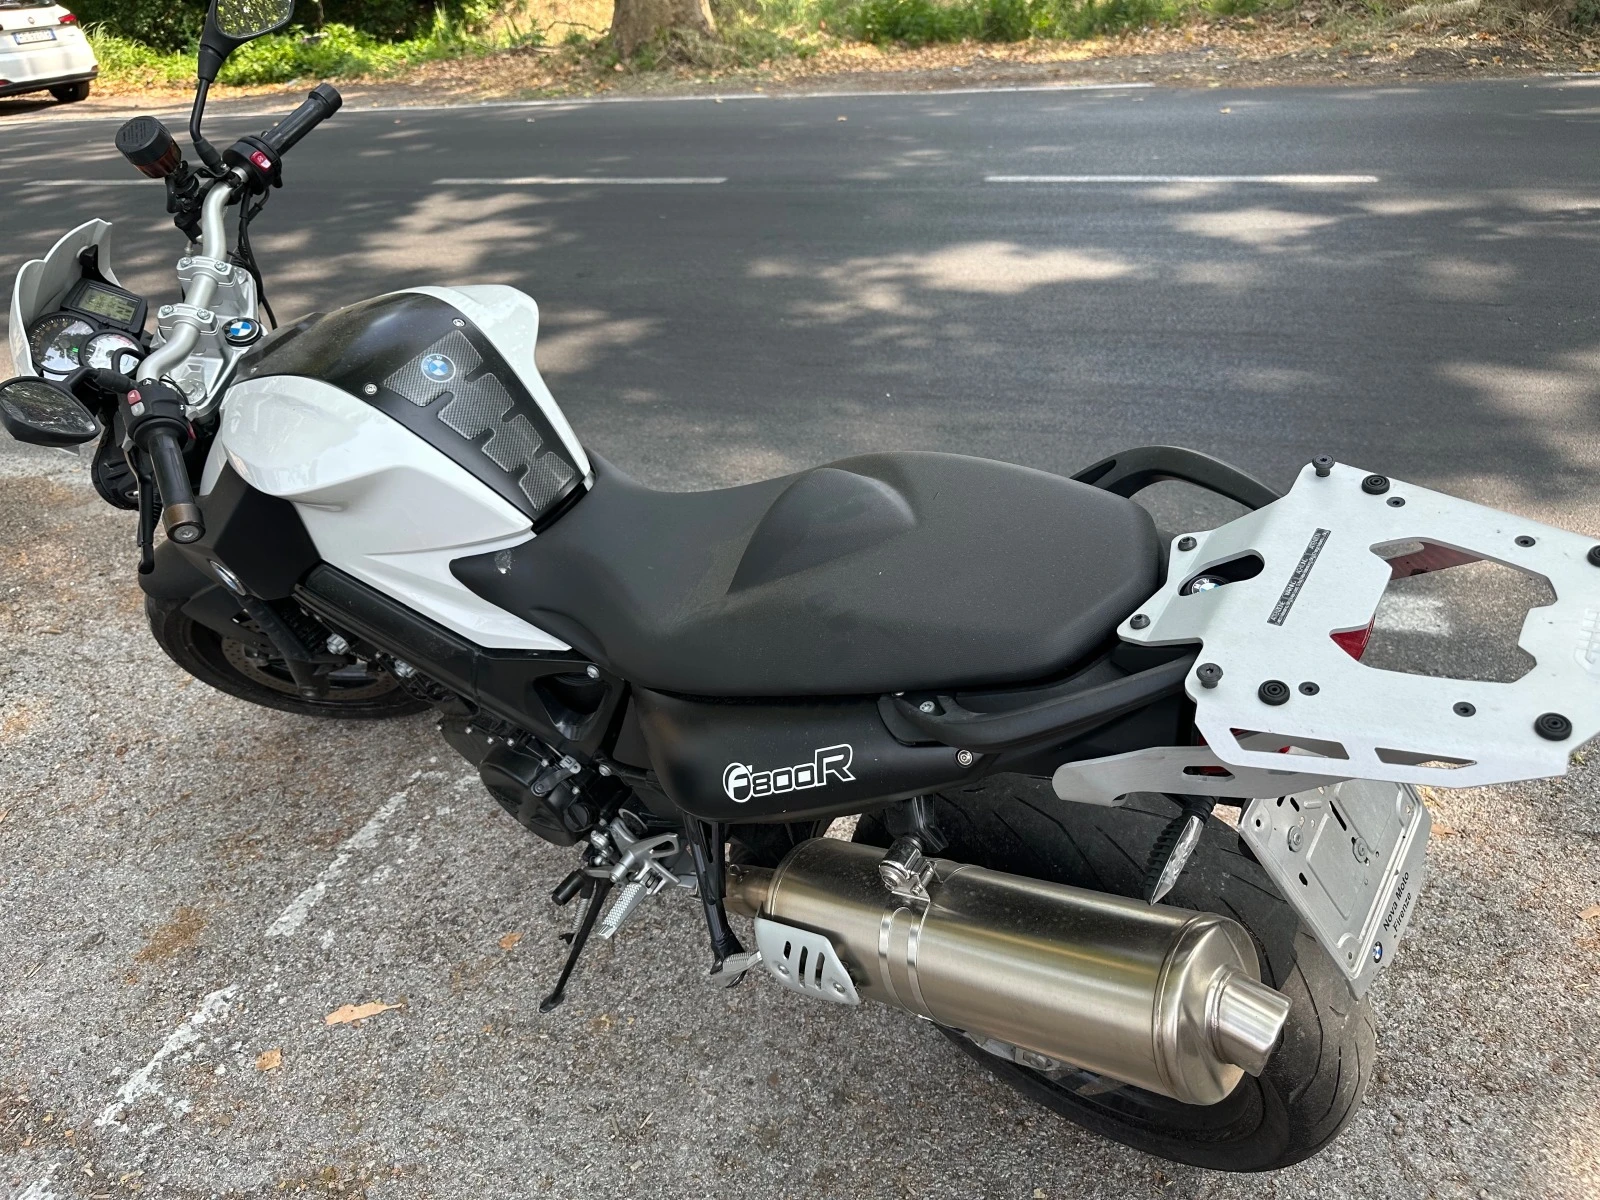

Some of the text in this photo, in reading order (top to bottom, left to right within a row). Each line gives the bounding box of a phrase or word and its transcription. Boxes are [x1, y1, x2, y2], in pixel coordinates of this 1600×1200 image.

[723, 744, 856, 803] F800R
[1383, 872, 1409, 931] Nova Moto
[1393, 892, 1411, 932] Firenze
